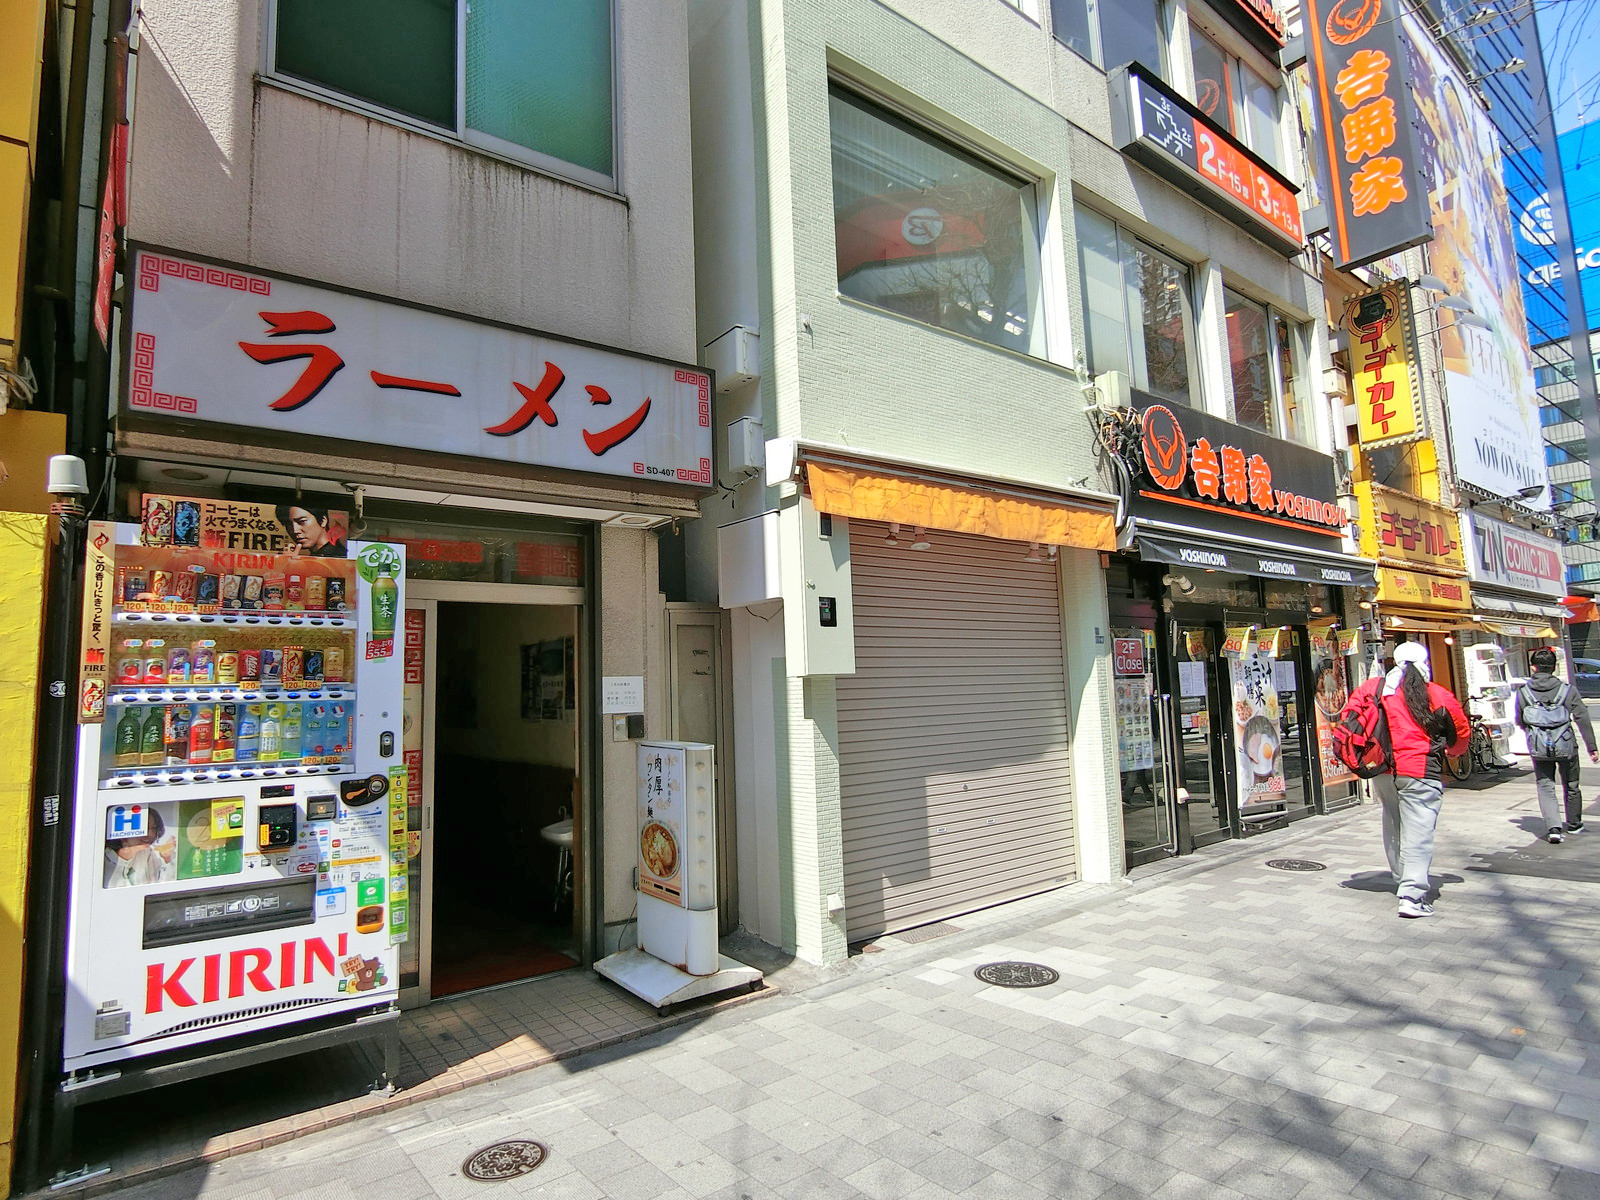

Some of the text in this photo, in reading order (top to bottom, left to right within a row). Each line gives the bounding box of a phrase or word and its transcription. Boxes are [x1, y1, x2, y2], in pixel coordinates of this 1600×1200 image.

[1160, 97, 1171, 113] 3F
[1182, 128, 1192, 143] 2F
[1335, 49, 1407, 217] 吉野家
[1200, 133, 1226, 181] 2F
[1257, 176, 1280, 220] 3F
[238, 311, 651, 456] ラーメン
[1360, 318, 1398, 435] ゴーゴーカレー
[1474, 436, 1500, 475] NOW
[646, 466, 675, 478] SD-407
[1191, 437, 1275, 511] 吉野家
[206, 503, 260, 517] コーヒーは
[205, 514, 280, 532] 火でうまくなる。
[1380, 508, 1457, 557] ゴーゴーカレー
[213, 552, 275, 570] KIRIN
[360, 548, 401, 571] でかっ
[1505, 540, 1551, 577] COMIC ZIN
[380, 594, 392, 618] 生茶
[86, 647, 105, 664] 新
[368, 640, 393, 650] たっぷり
[1122, 642, 1136, 654] 2F
[1225, 639, 1242, 652] 80
[84, 664, 106, 672] FIRE
[1116, 655, 1142, 670] Close
[653, 753, 663, 796] 肉厚
[145, 932, 348, 1014] KIRIN
